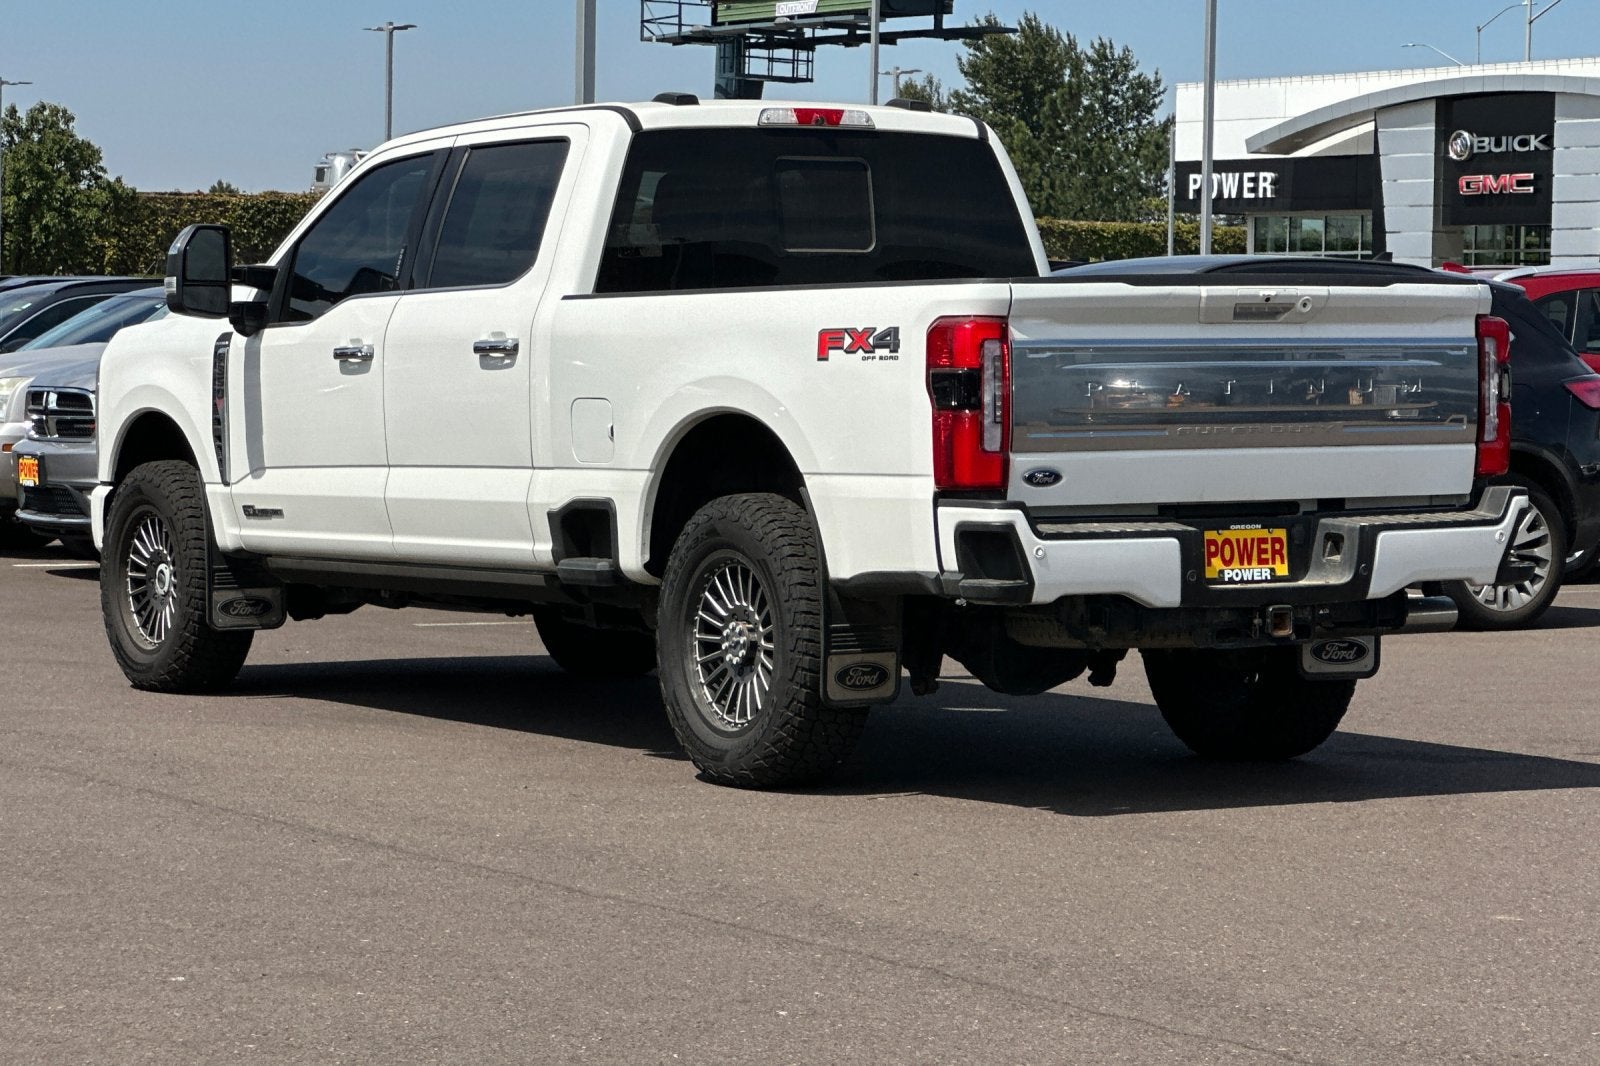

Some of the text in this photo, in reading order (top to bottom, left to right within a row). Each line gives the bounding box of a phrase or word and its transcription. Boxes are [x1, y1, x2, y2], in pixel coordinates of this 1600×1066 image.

[1473, 134, 1552, 153] BUICK
[1458, 173, 1534, 195] GMC
[816, 326, 900, 361] FX4
[1087, 377, 1422, 398] PLATINUM
[1206, 537, 1286, 567] POWER
[1224, 568, 1271, 581] POWER
[229, 600, 263, 615] Ford
[1321, 642, 1358, 660] Ford
[846, 667, 880, 686] Ford
